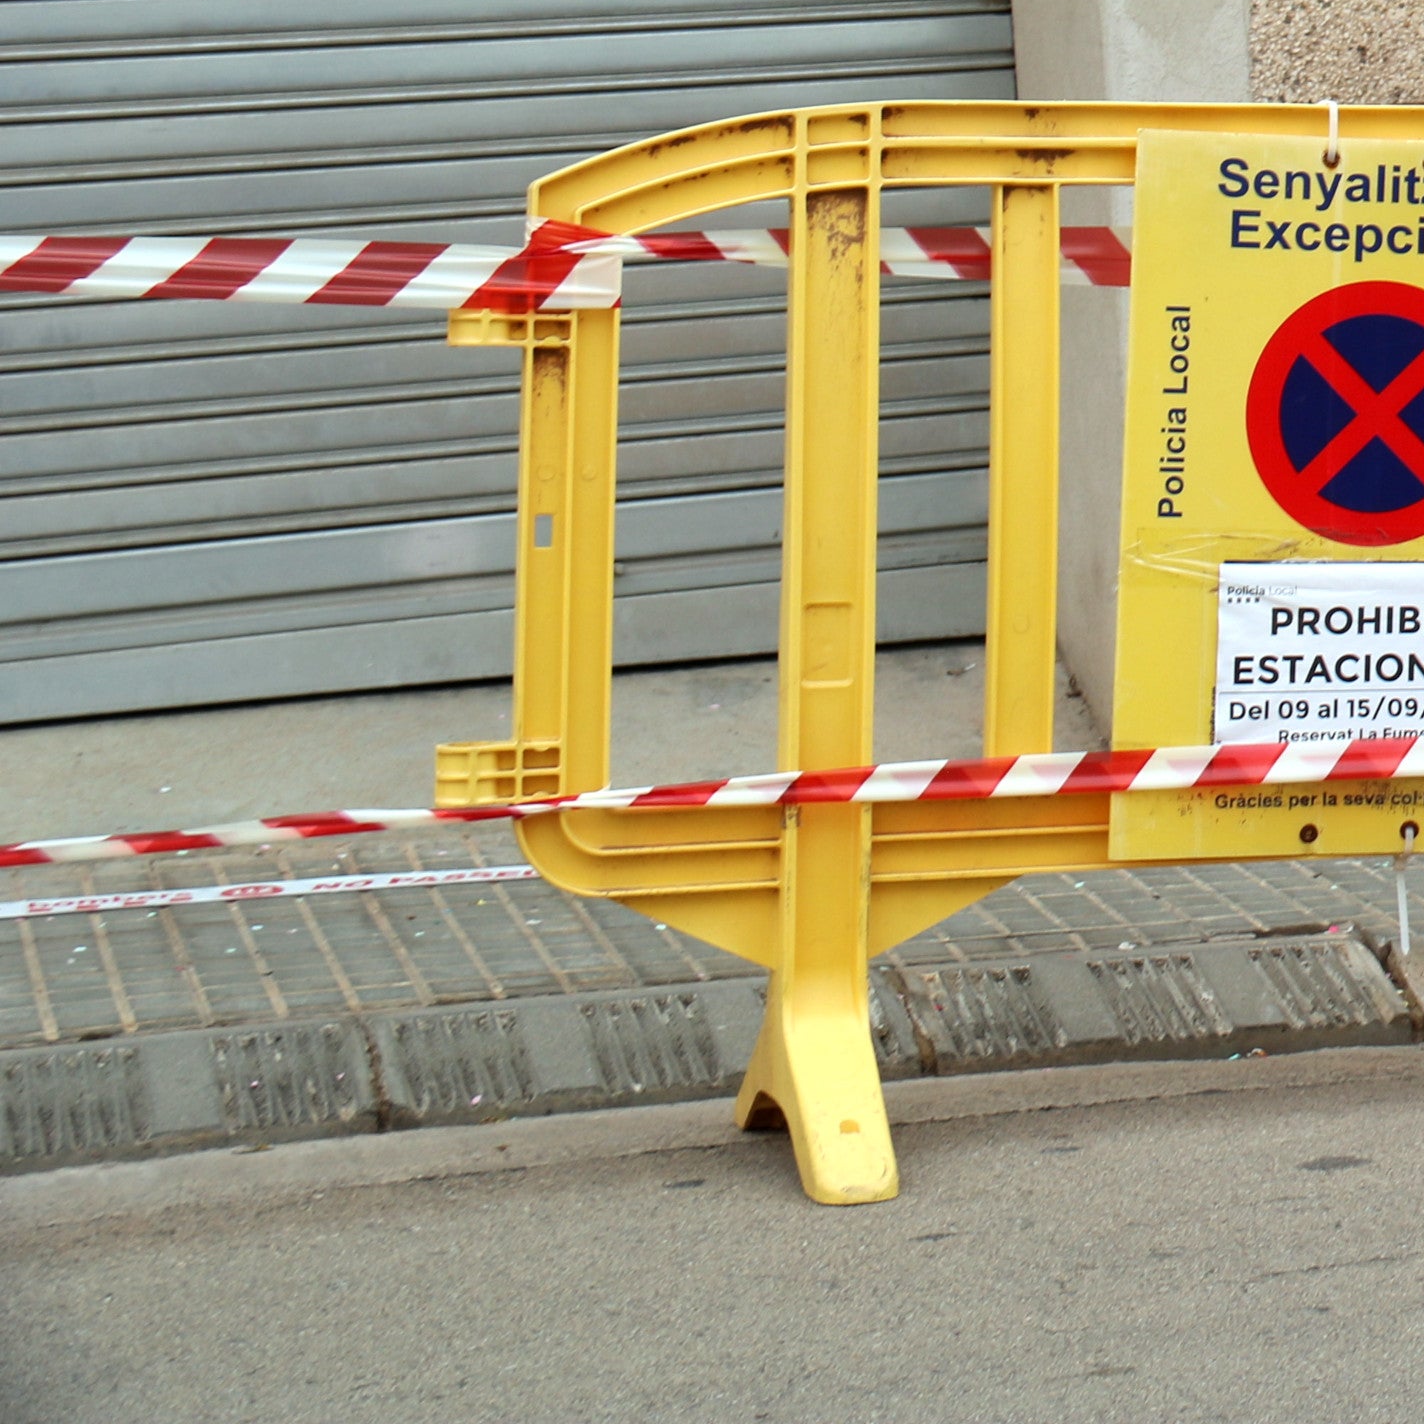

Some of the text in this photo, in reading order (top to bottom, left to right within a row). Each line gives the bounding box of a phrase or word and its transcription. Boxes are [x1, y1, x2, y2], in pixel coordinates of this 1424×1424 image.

[1157, 306, 1191, 518] Policia Local
[1268, 585, 1298, 596] Local
[1229, 700, 1269, 720] Del
[1278, 699, 1310, 719] 09
[1318, 698, 1338, 718] al
[1278, 728, 1353, 743] Reservat
[1359, 728, 1377, 740] La
[1215, 793, 1283, 809] Gràcies
[1288, 793, 1317, 809] per
[1322, 792, 1337, 807] la
[1344, 793, 1385, 806] seva
[313, 879, 373, 890] NO
